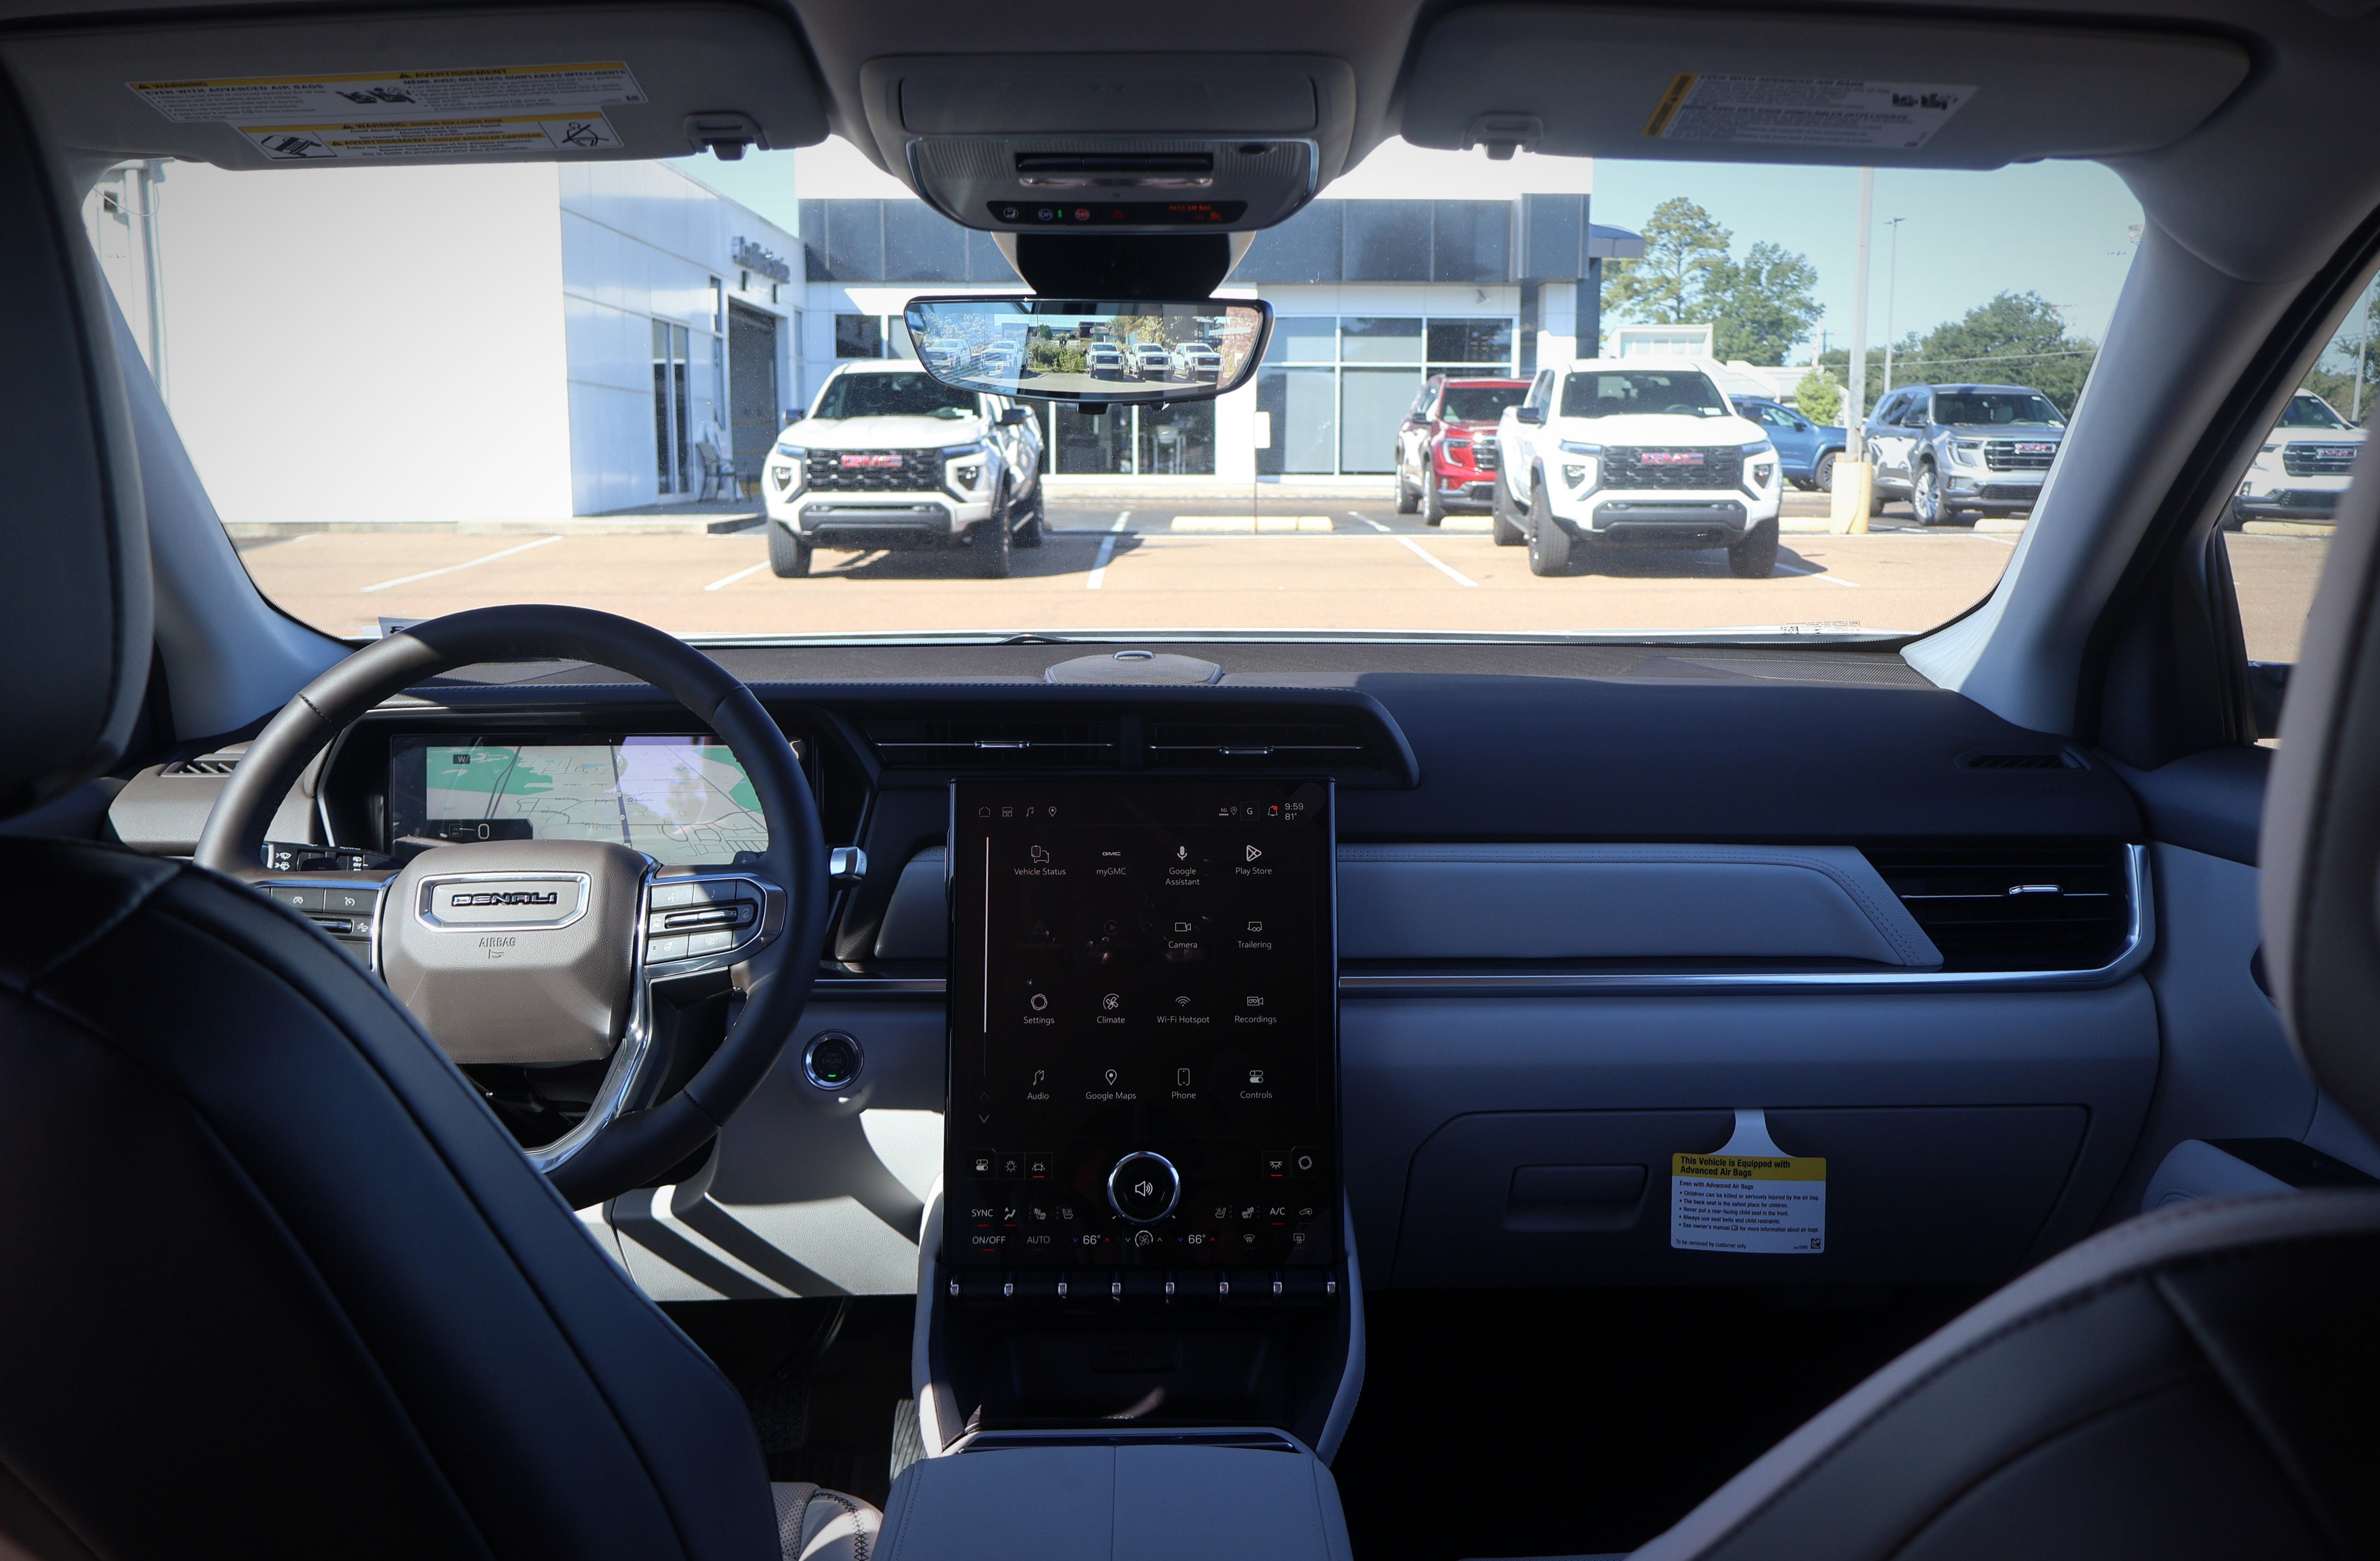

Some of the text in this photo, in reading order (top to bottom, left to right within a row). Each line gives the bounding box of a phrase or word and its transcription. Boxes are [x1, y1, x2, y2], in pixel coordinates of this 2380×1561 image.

[841, 455, 903, 468] GMC
[1642, 453, 1704, 465] GMC
[478, 823, 490, 839] 0
[1097, 868, 1126, 877] myGMC
[1169, 867, 1197, 877] Google
[1236, 867, 1251, 876] Play
[452, 891, 558, 907] DENALI
[479, 937, 516, 948] AIRBAG
[1237, 941, 1272, 951] Trailering
[1023, 1016, 1055, 1026] Settings
[1179, 1016, 1210, 1026] Hotspot
[1235, 1015, 1277, 1025] Recordings
[1086, 1092, 1137, 1101] Google Maps
[1240, 1091, 1273, 1099] Controls
[1681, 1156, 1696, 1164] This
[1699, 1158, 1726, 1166] Vehicle
[1738, 1159, 1772, 1169] Equipped
[1680, 1165, 1717, 1175] Advanced
[1733, 1169, 1752, 1178] Bags
[1270, 1207, 1286, 1216] A/C
[972, 1235, 1006, 1245] ON/OFF
[1083, 1235, 1101, 1244] 66°
[1188, 1234, 1206, 1244] 66°
